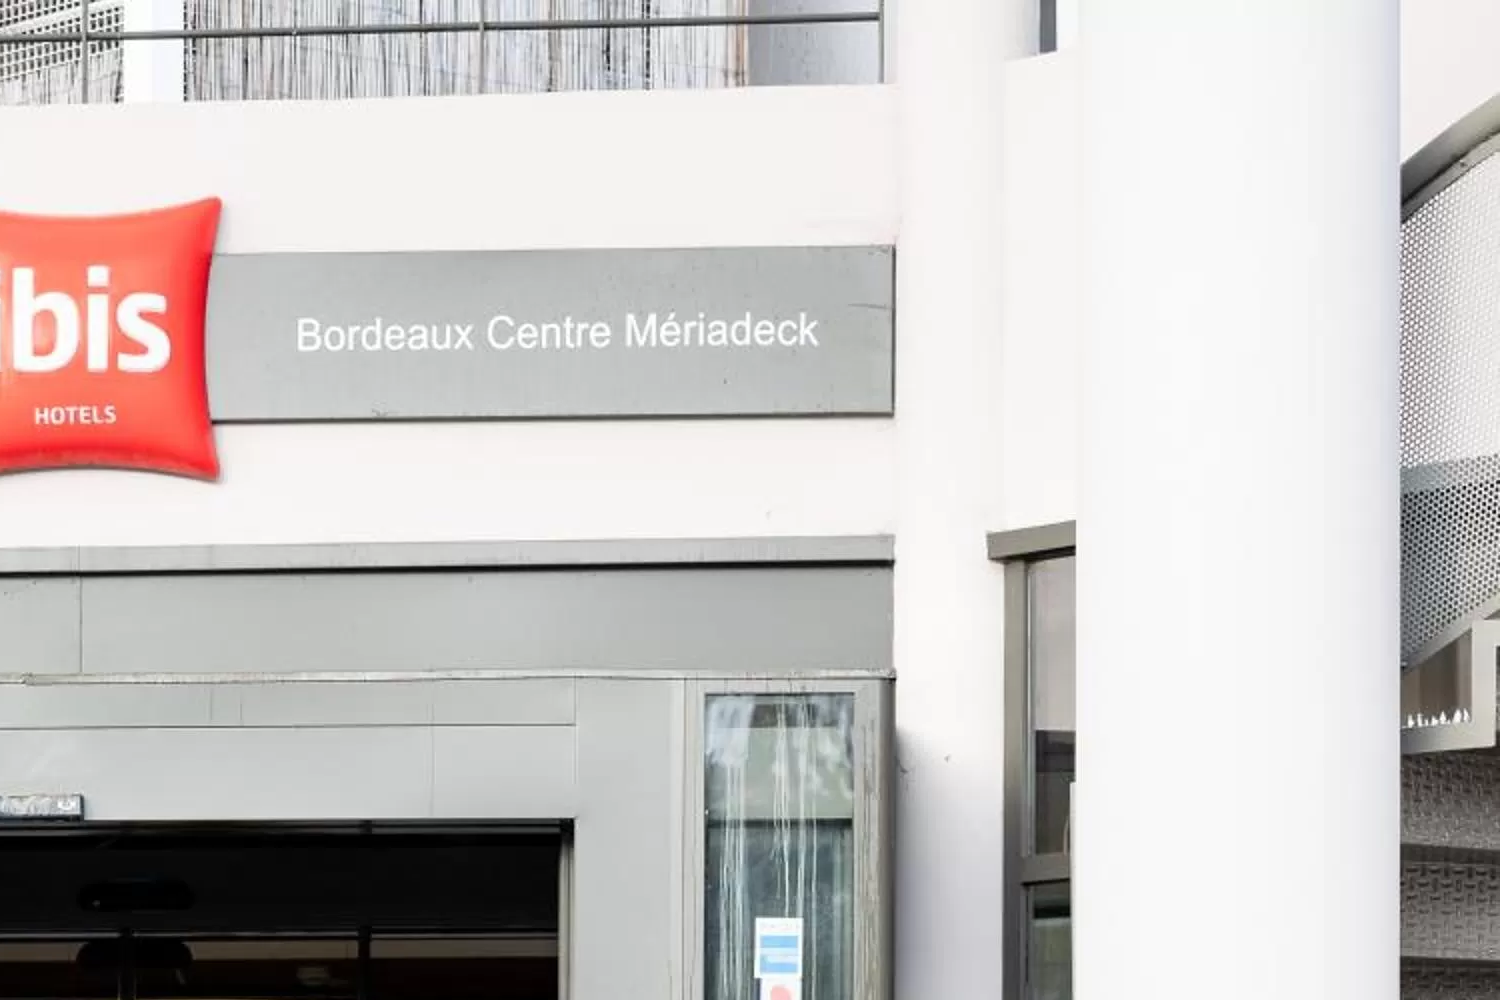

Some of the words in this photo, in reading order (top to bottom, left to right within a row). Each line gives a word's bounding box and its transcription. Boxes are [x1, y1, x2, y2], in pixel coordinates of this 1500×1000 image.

[296, 317, 475, 353] Bordeaux
[486, 315, 612, 350] Centre
[624, 311, 820, 348] Mériadeck
[34, 405, 117, 425] HOTELS
